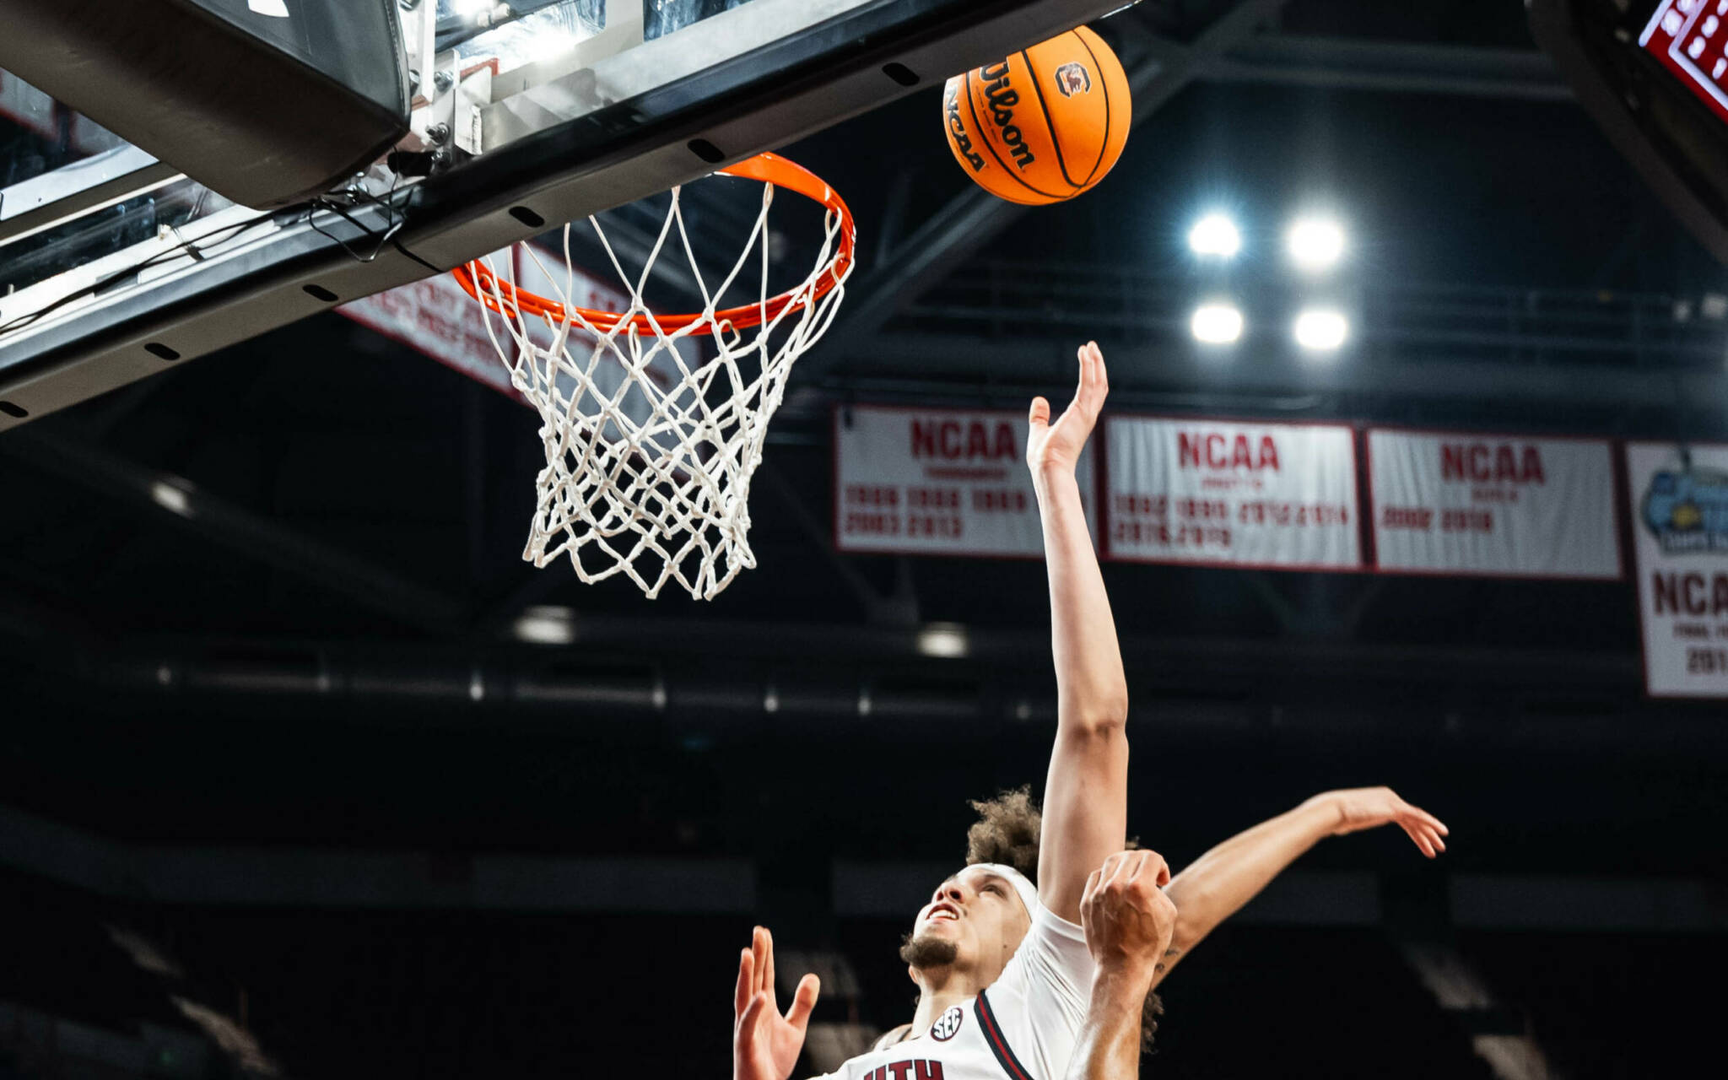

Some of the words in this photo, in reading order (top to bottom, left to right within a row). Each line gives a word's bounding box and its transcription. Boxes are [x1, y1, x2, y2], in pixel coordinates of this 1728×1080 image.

[946, 82, 987, 173] NCAA
[911, 418, 1018, 461] NCAA
[1178, 431, 1280, 472] NCAA
[1441, 443, 1545, 486] NCAA
[931, 1008, 962, 1040] SEC
